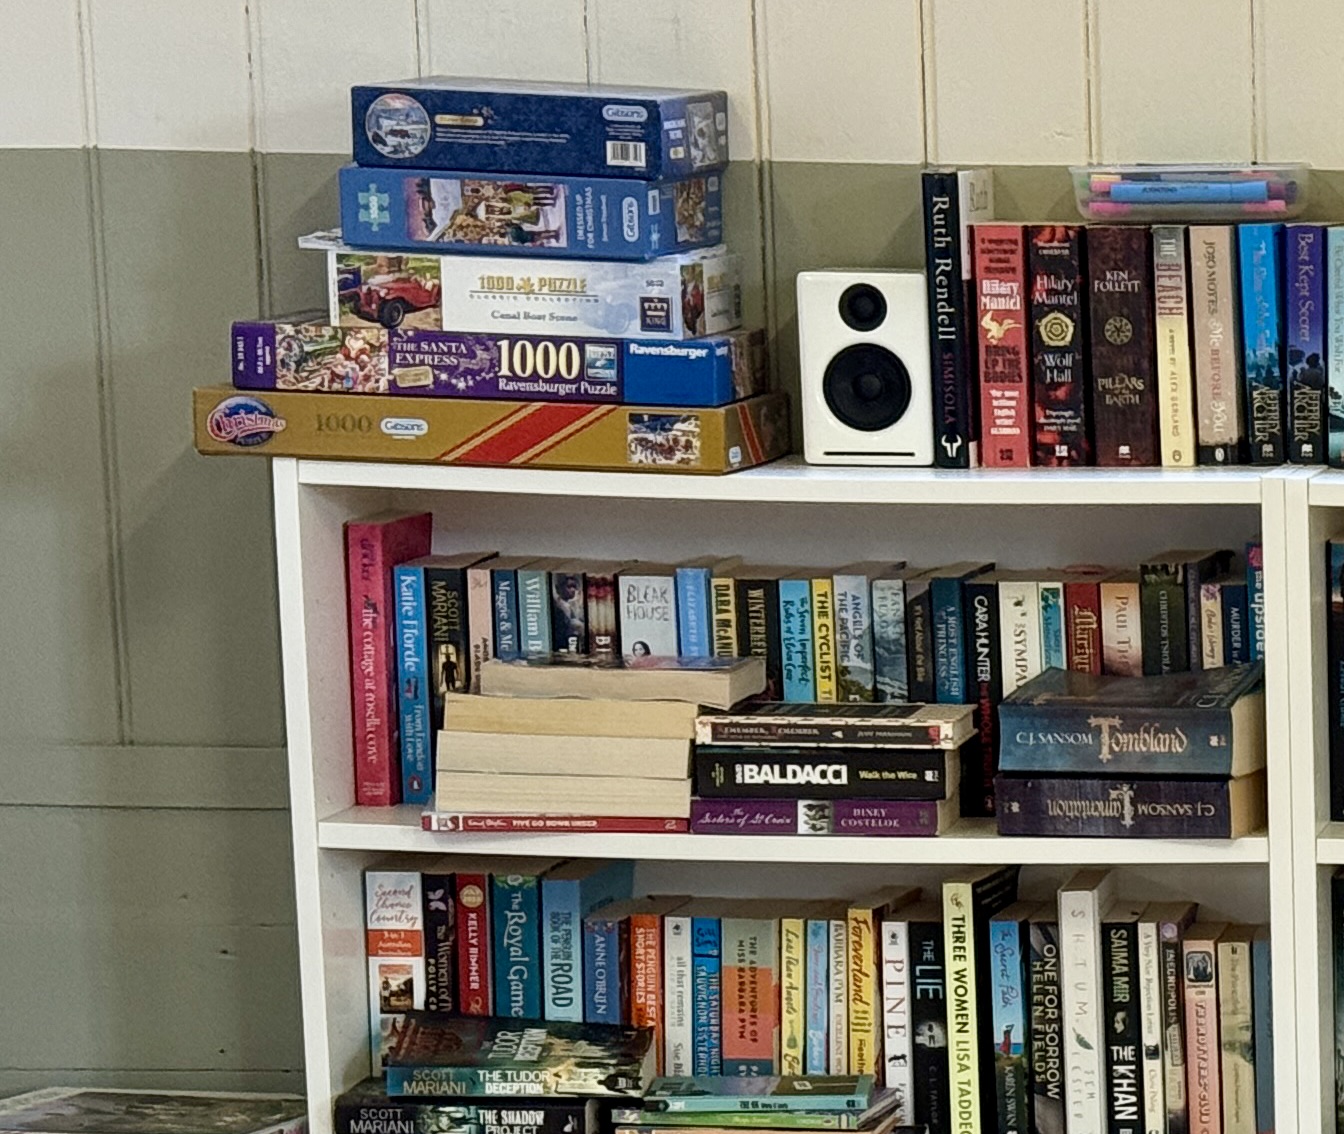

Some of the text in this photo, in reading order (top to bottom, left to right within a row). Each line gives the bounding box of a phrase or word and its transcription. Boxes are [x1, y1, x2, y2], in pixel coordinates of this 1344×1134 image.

[1156, 238, 1184, 317] THE BEACH
[932, 195, 955, 424] Ruth Rendell SIMISOLA
[393, 342, 467, 355] THE SANTA
[396, 353, 458, 366] EXPRESS
[499, 340, 581, 378] 1000
[630, 343, 709, 358] Ravensburger
[499, 378, 617, 395] Ravensburger Puzzle
[317, 416, 372, 433] 1000
[818, 592, 831, 682] THE CYCLIST
[975, 596, 990, 682] CARA HUNTER
[744, 765, 848, 785] BALDACCI
[951, 915, 967, 961] THREE
[503, 911, 529, 1017] Royal Game
[550, 963, 574, 1007] ROAD
[916, 965, 942, 1000] LIE
[1110, 929, 1130, 1002] SAIMA MIR
[885, 958, 906, 1039] PINE
[953, 968, 969, 1033] WOMEN
[1032, 961, 1046, 1083] HELEN FIELDS
[1043, 944, 1060, 1099] ONE FOR SORROW
[478, 1070, 551, 1081] THE TUDOR
[955, 1040, 970, 1073] LISA
[485, 1083, 544, 1093] DECEPTION
[1113, 1064, 1137, 1120] KHAN
